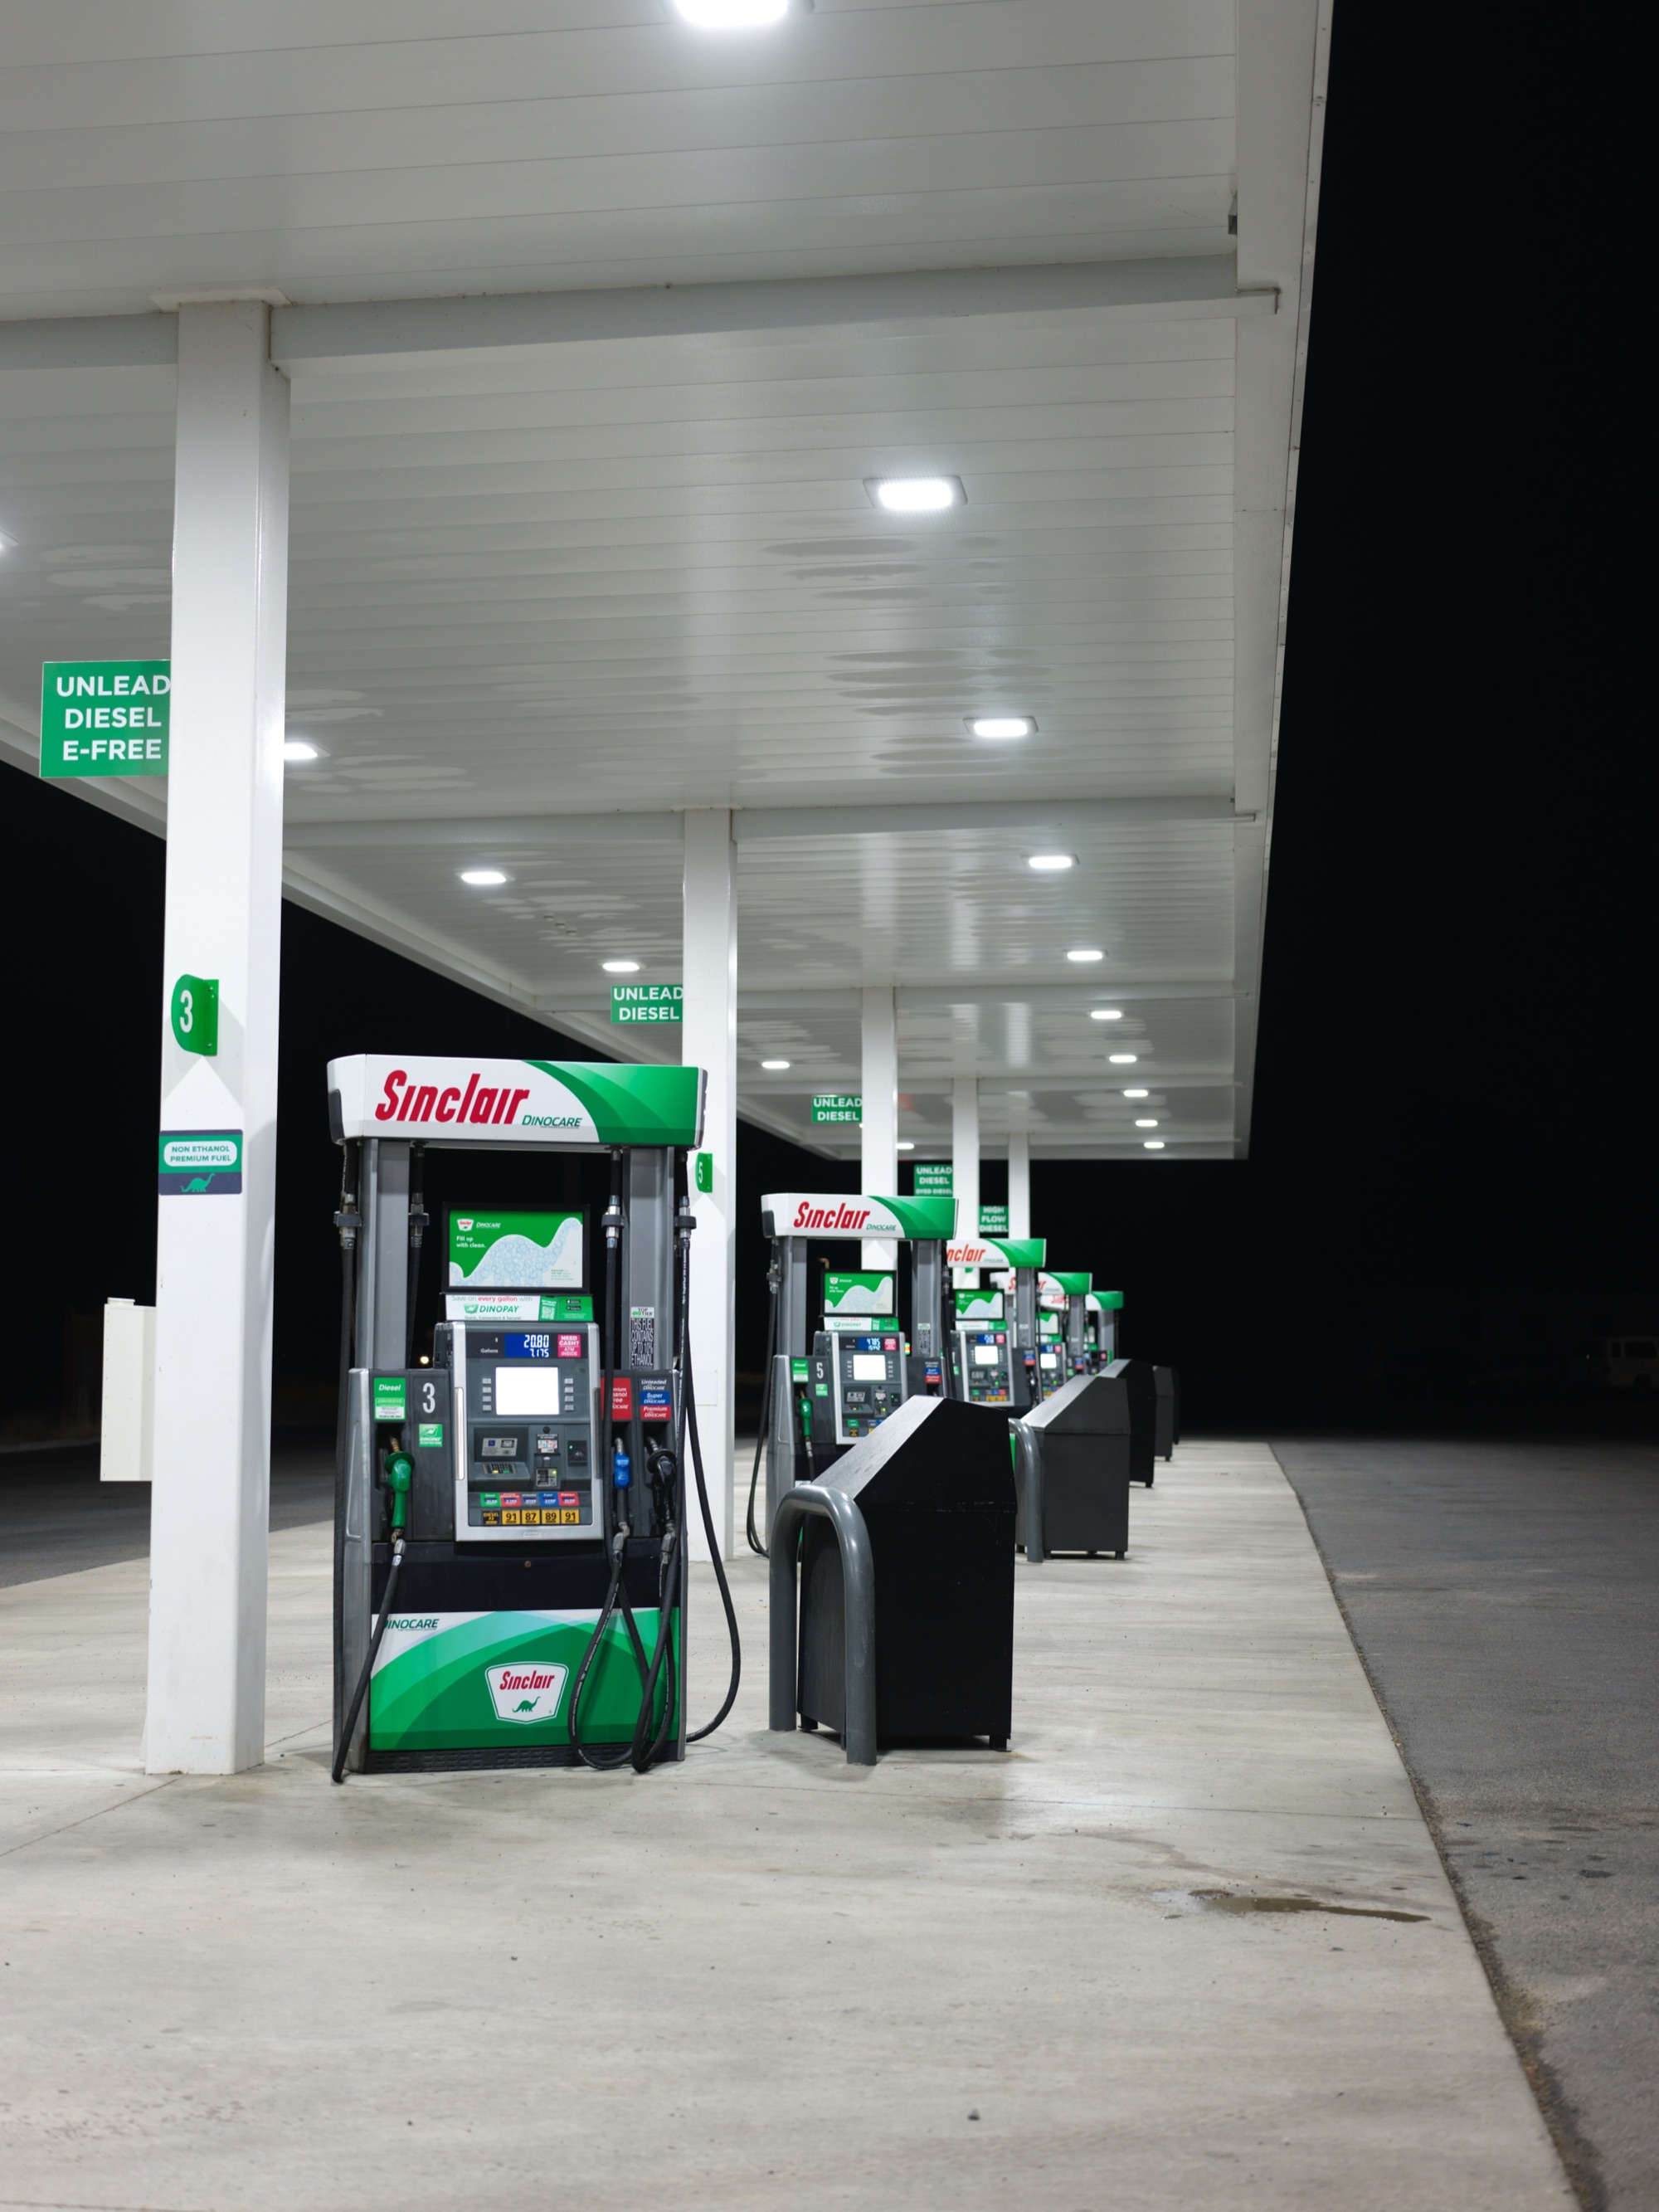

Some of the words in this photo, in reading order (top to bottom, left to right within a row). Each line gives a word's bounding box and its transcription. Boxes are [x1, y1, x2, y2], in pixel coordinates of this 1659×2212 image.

[56, 675, 171, 697] UNLEAD
[65, 707, 162, 728] DIESEL
[63, 738, 162, 761] E-FREE
[614, 987, 683, 1001] UNLEAD
[179, 989, 193, 1033] 3
[619, 1007, 679, 1021] DIESEL
[374, 1069, 530, 1124] Sinclair
[813, 1098, 861, 1108] UNLEAD
[521, 1114, 582, 1128] DINOCARE
[817, 1111, 859, 1121] DIESEL
[698, 1162, 703, 1183] 5
[916, 1166, 952, 1175] UNLEAD
[918, 1177, 950, 1185] DIESEL
[793, 1201, 870, 1229] Sinclair
[981, 1215, 1006, 1223] FLOW
[946, 1244, 985, 1262] nclair
[479, 1305, 518, 1313] DINOPAY
[631, 1318, 642, 1330] THIS
[642, 1318, 654, 1330] FUEL
[631, 1330, 654, 1342] CONTAINS
[631, 1342, 637, 1353] UP
[637, 1342, 644, 1353] TO
[644, 1342, 654, 1353] 10%
[631, 1353, 654, 1366] ETHANOL
[816, 1362, 824, 1379] 5
[422, 1382, 435, 1413] 3
[545, 1512, 557, 1520] 89
[565, 1512, 576, 1520] 91
[499, 1670, 555, 1690] Sinclair
